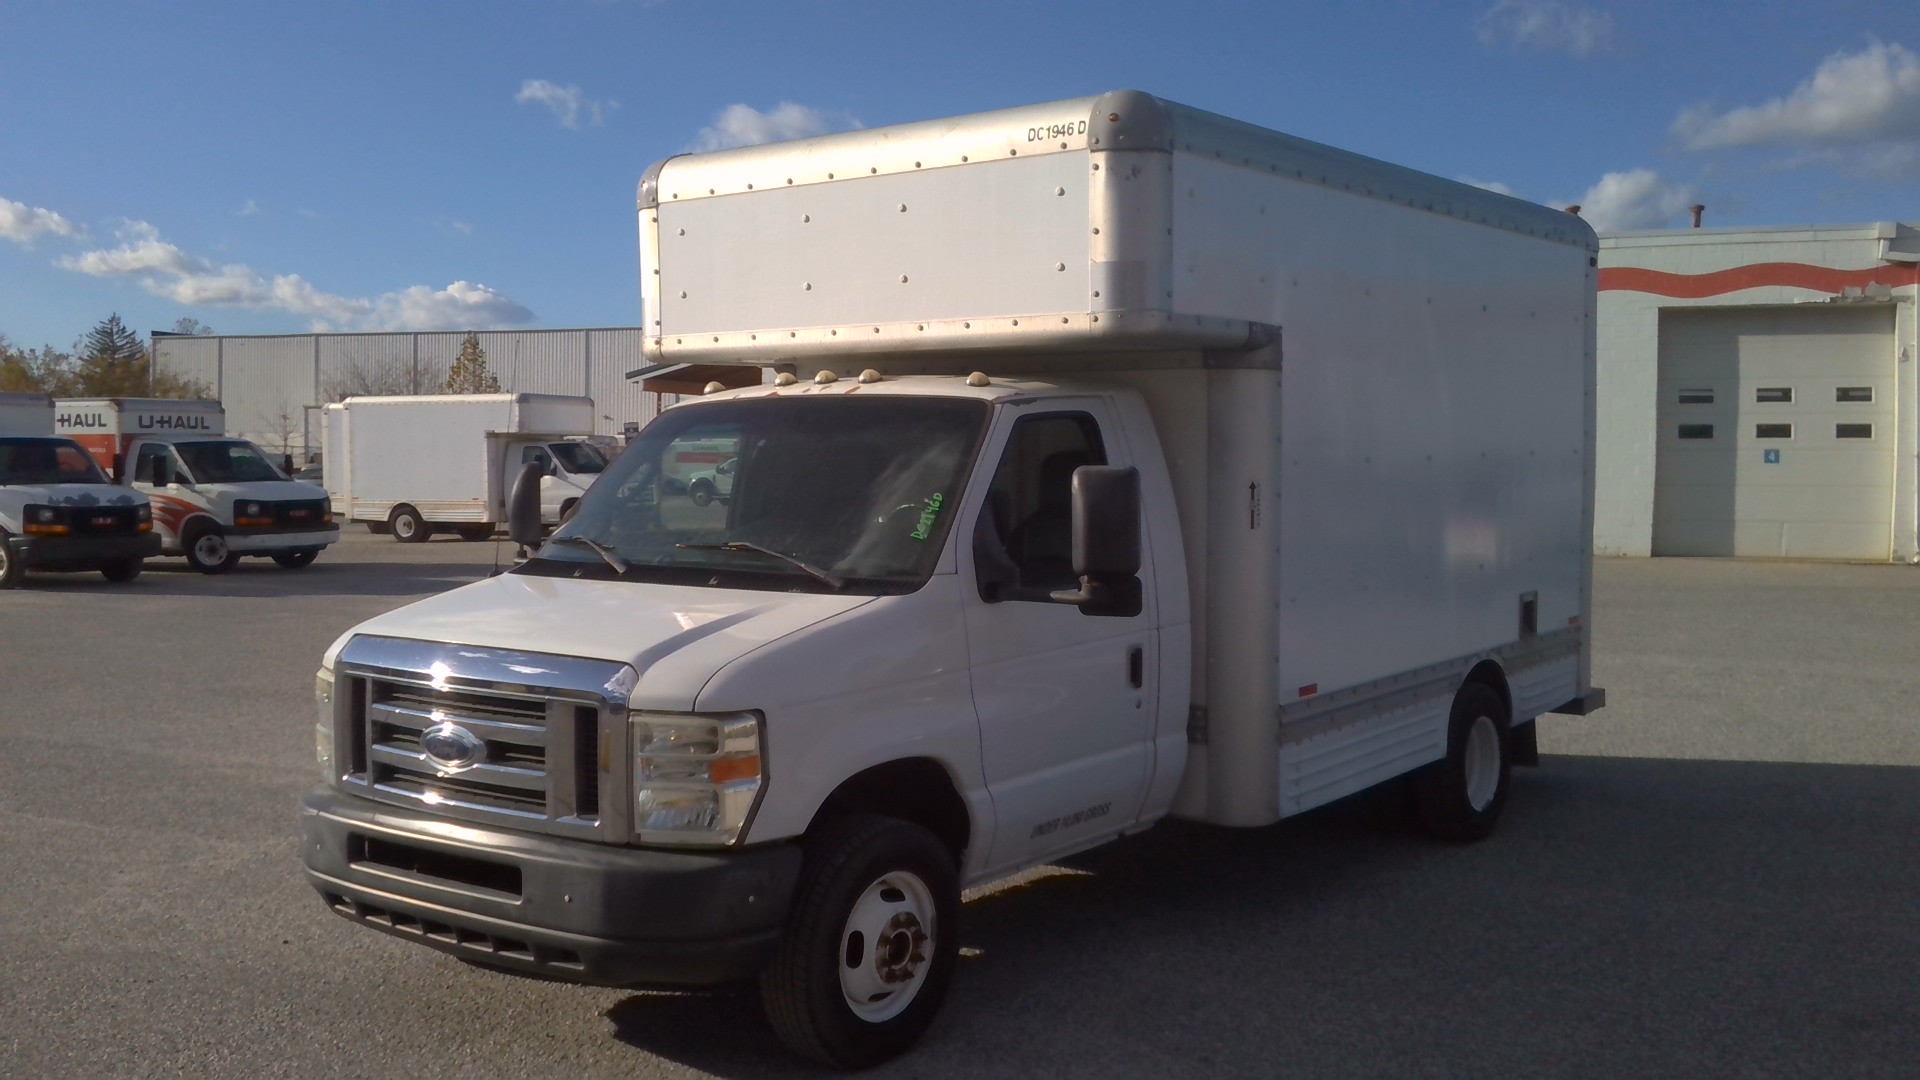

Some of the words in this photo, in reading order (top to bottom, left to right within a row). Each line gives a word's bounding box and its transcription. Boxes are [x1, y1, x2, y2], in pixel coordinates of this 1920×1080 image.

[1028, 122, 1074, 142] DC1946
[57, 413, 107, 427] -HAUL
[138, 415, 210, 430] U-HAUL
